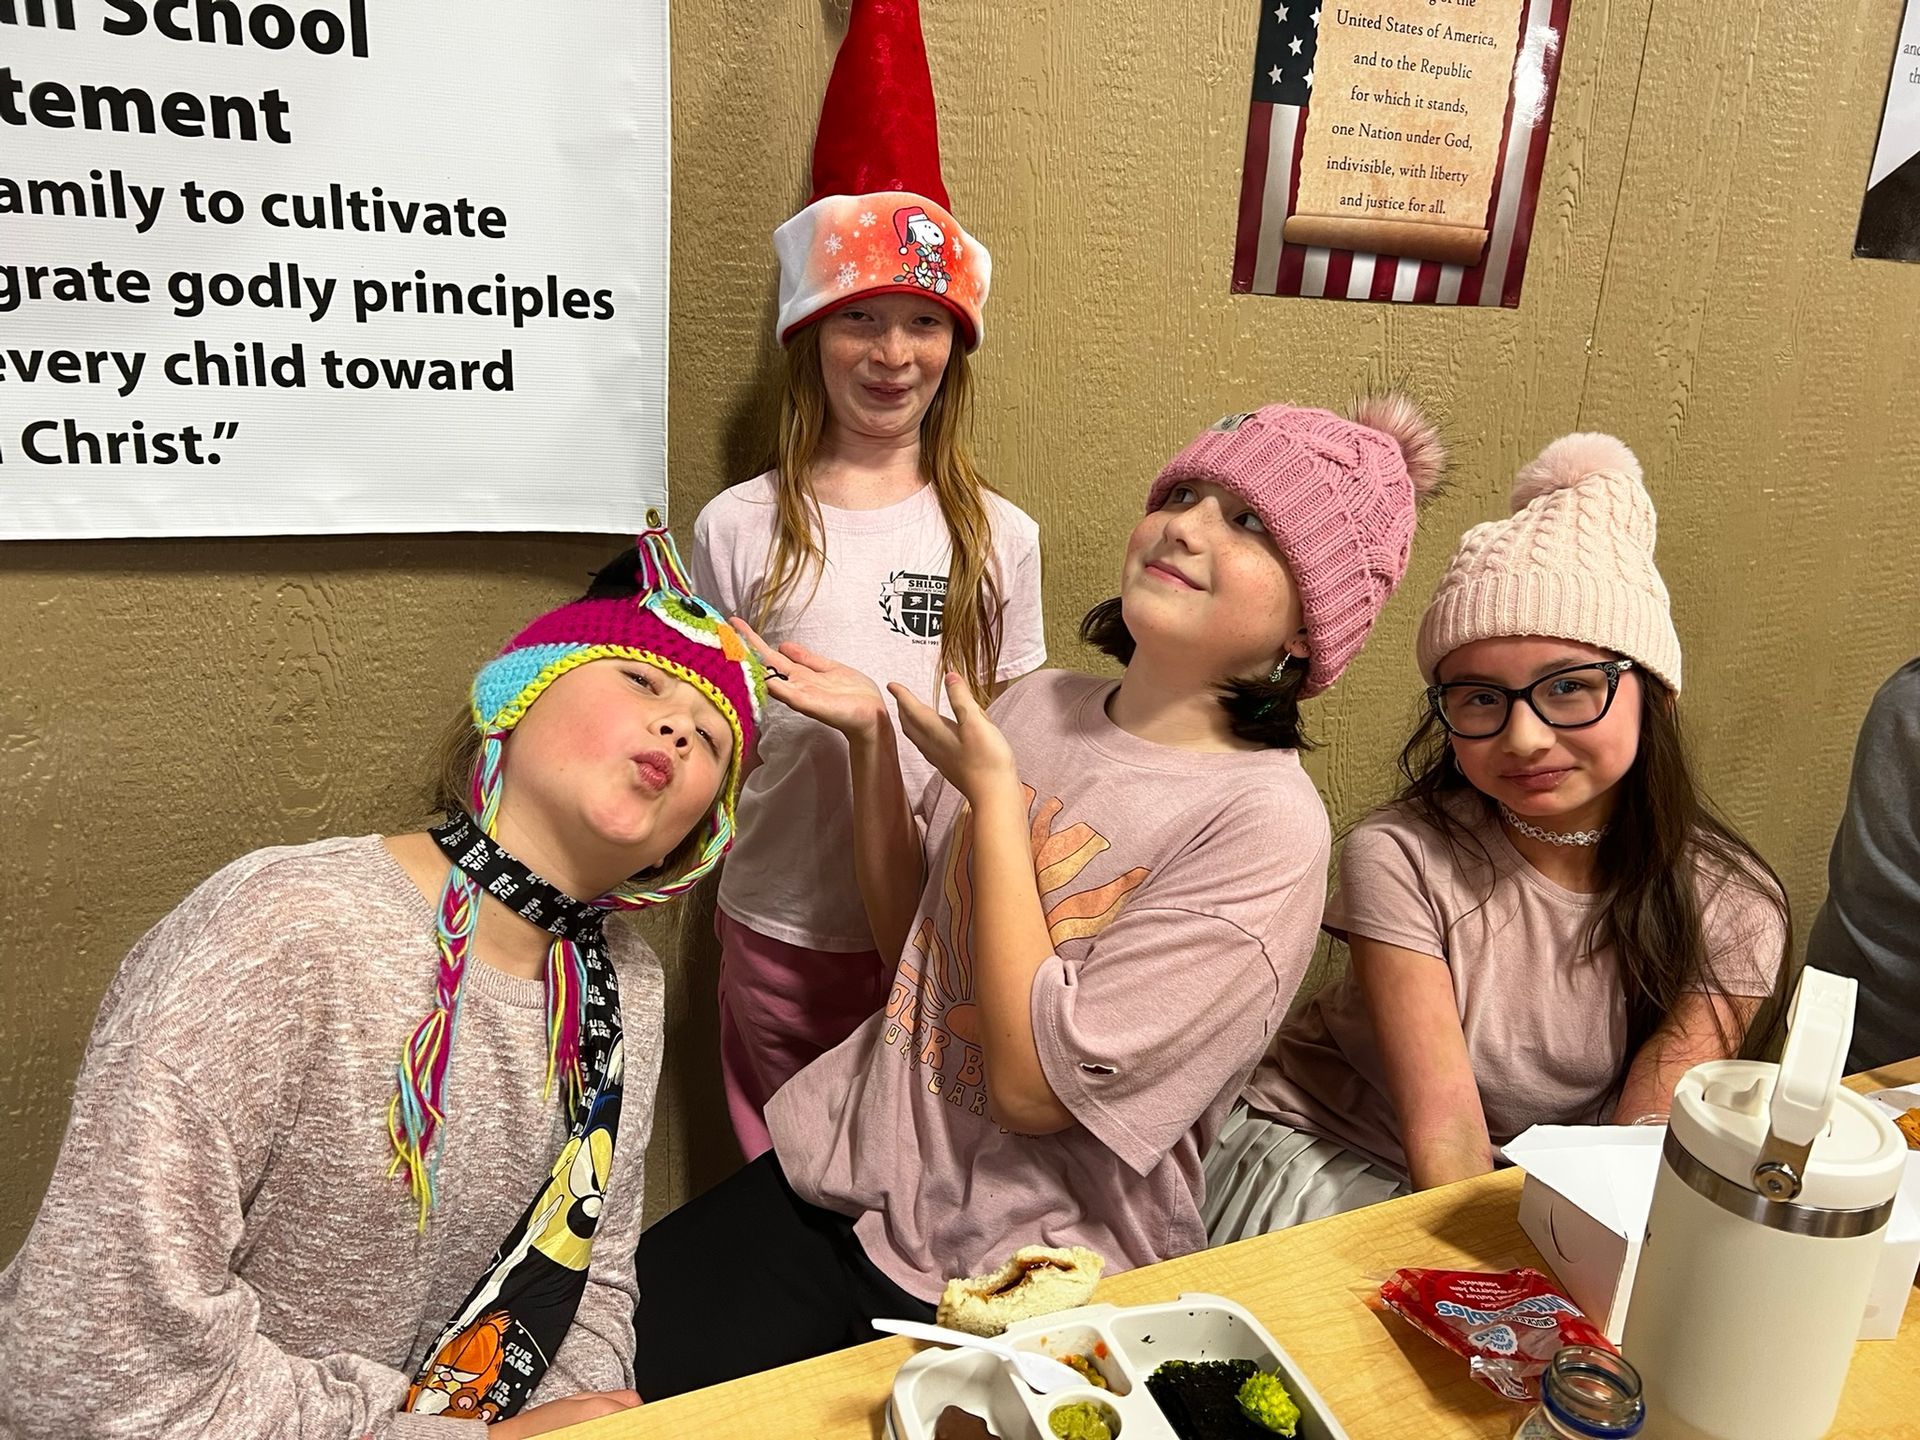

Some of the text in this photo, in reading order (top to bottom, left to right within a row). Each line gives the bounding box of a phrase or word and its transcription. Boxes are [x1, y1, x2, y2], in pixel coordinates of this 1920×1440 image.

[103, 0, 369, 57] School
[1337, 9, 1497, 49] United States of America,
[1353, 51, 1473, 79] and to the Republic
[1350, 85, 1469, 116] for which it stands,
[1332, 122, 1473, 152] one Nation under God,
[1326, 155, 1469, 187] indivisible, with liberty
[181, 181, 243, 224] to
[262, 184, 506, 239] cultivate
[1339, 193, 1446, 214] and justice for all.
[169, 263, 336, 323] godly
[354, 270, 614, 327] principles
[0, 341, 513, 397] very child toward
[504, 1354, 534, 1376] ARS
[505, 1342, 533, 1364] FUR
